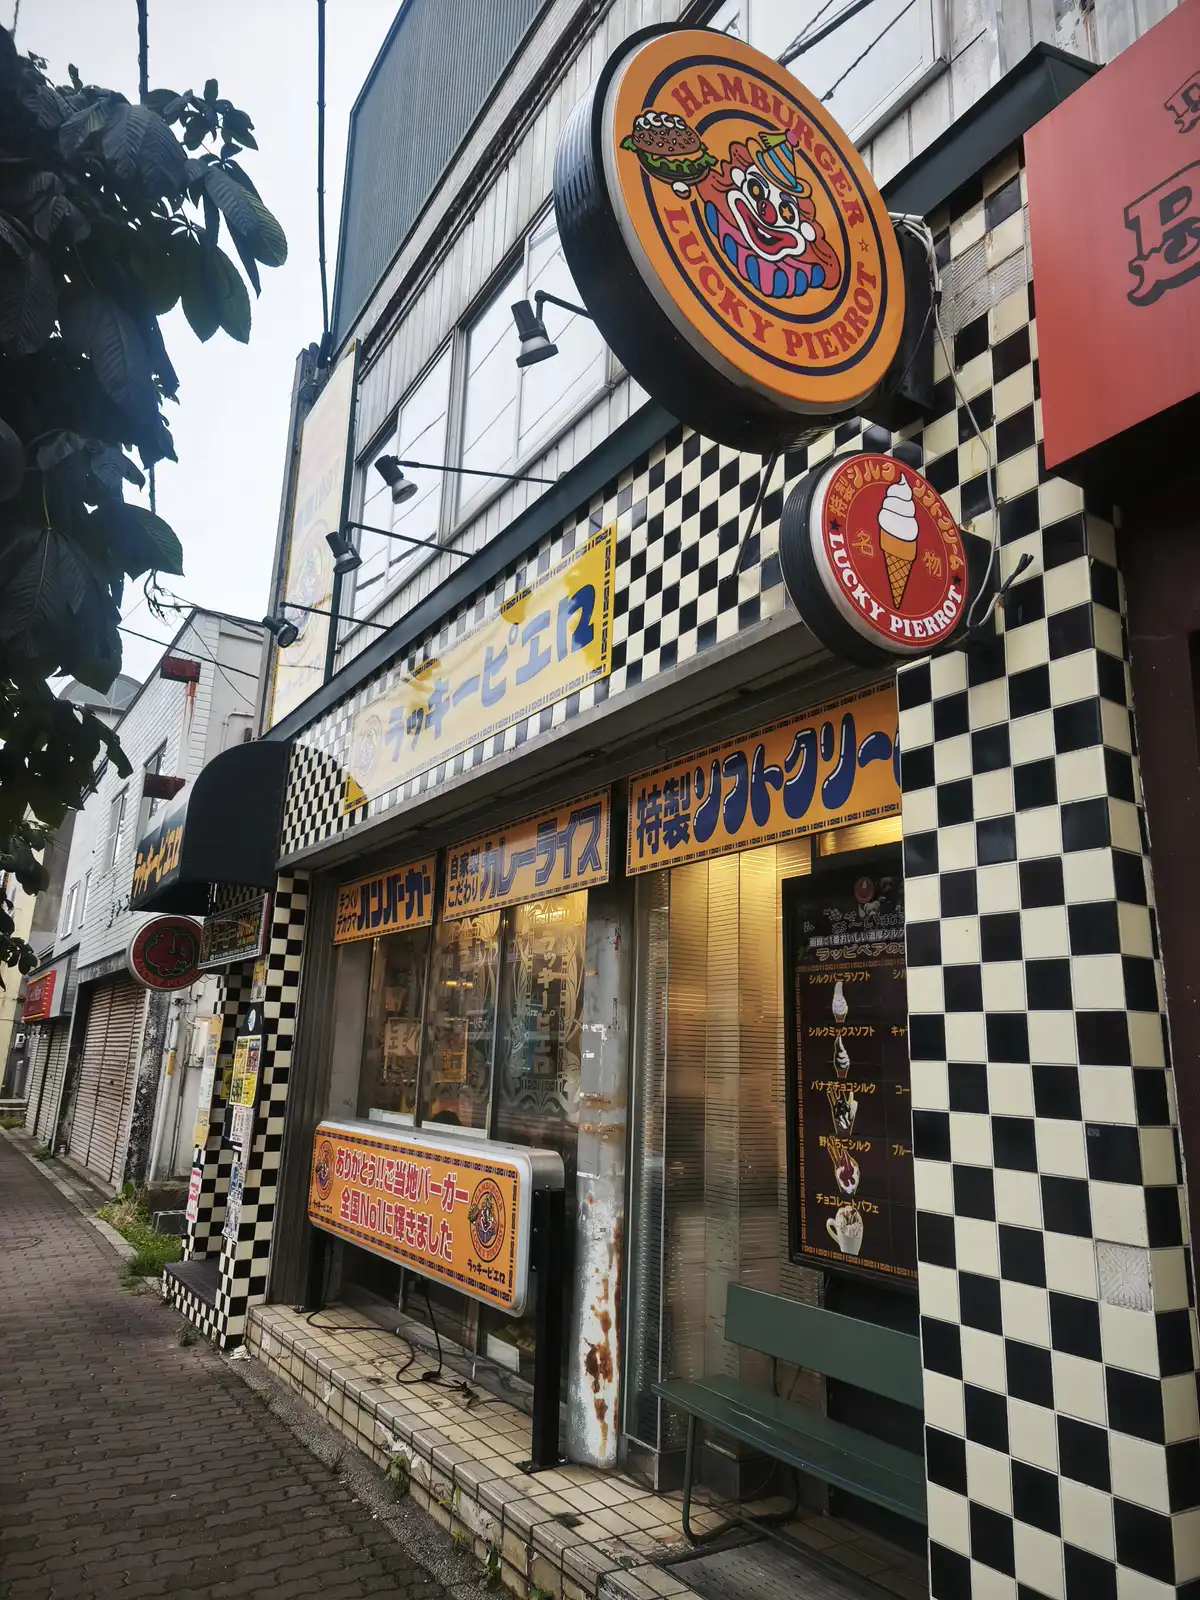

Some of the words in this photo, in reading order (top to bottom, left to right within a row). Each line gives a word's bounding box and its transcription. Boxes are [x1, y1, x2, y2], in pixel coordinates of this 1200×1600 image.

[671, 73, 865, 228] HAMBURGER
[663, 205, 774, 343] LUCKY
[782, 261, 876, 360] PIERROT
[913, 479, 965, 571] ソフトクリーム
[829, 532, 885, 621] LUCKY
[890, 585, 963, 638] PIERROT
[385, 584, 596, 763] ラッキーピエロ
[636, 713, 900, 858] 特製ソフトクリー
[357, 864, 431, 931] ハンバーガー
[480, 802, 602, 902] カレーライス
[809, 970, 871, 985] シルクバニラソフト
[808, 1025, 875, 1037] シルクミックスソフト
[816, 1193, 879, 1214] チョコレートパフェ
